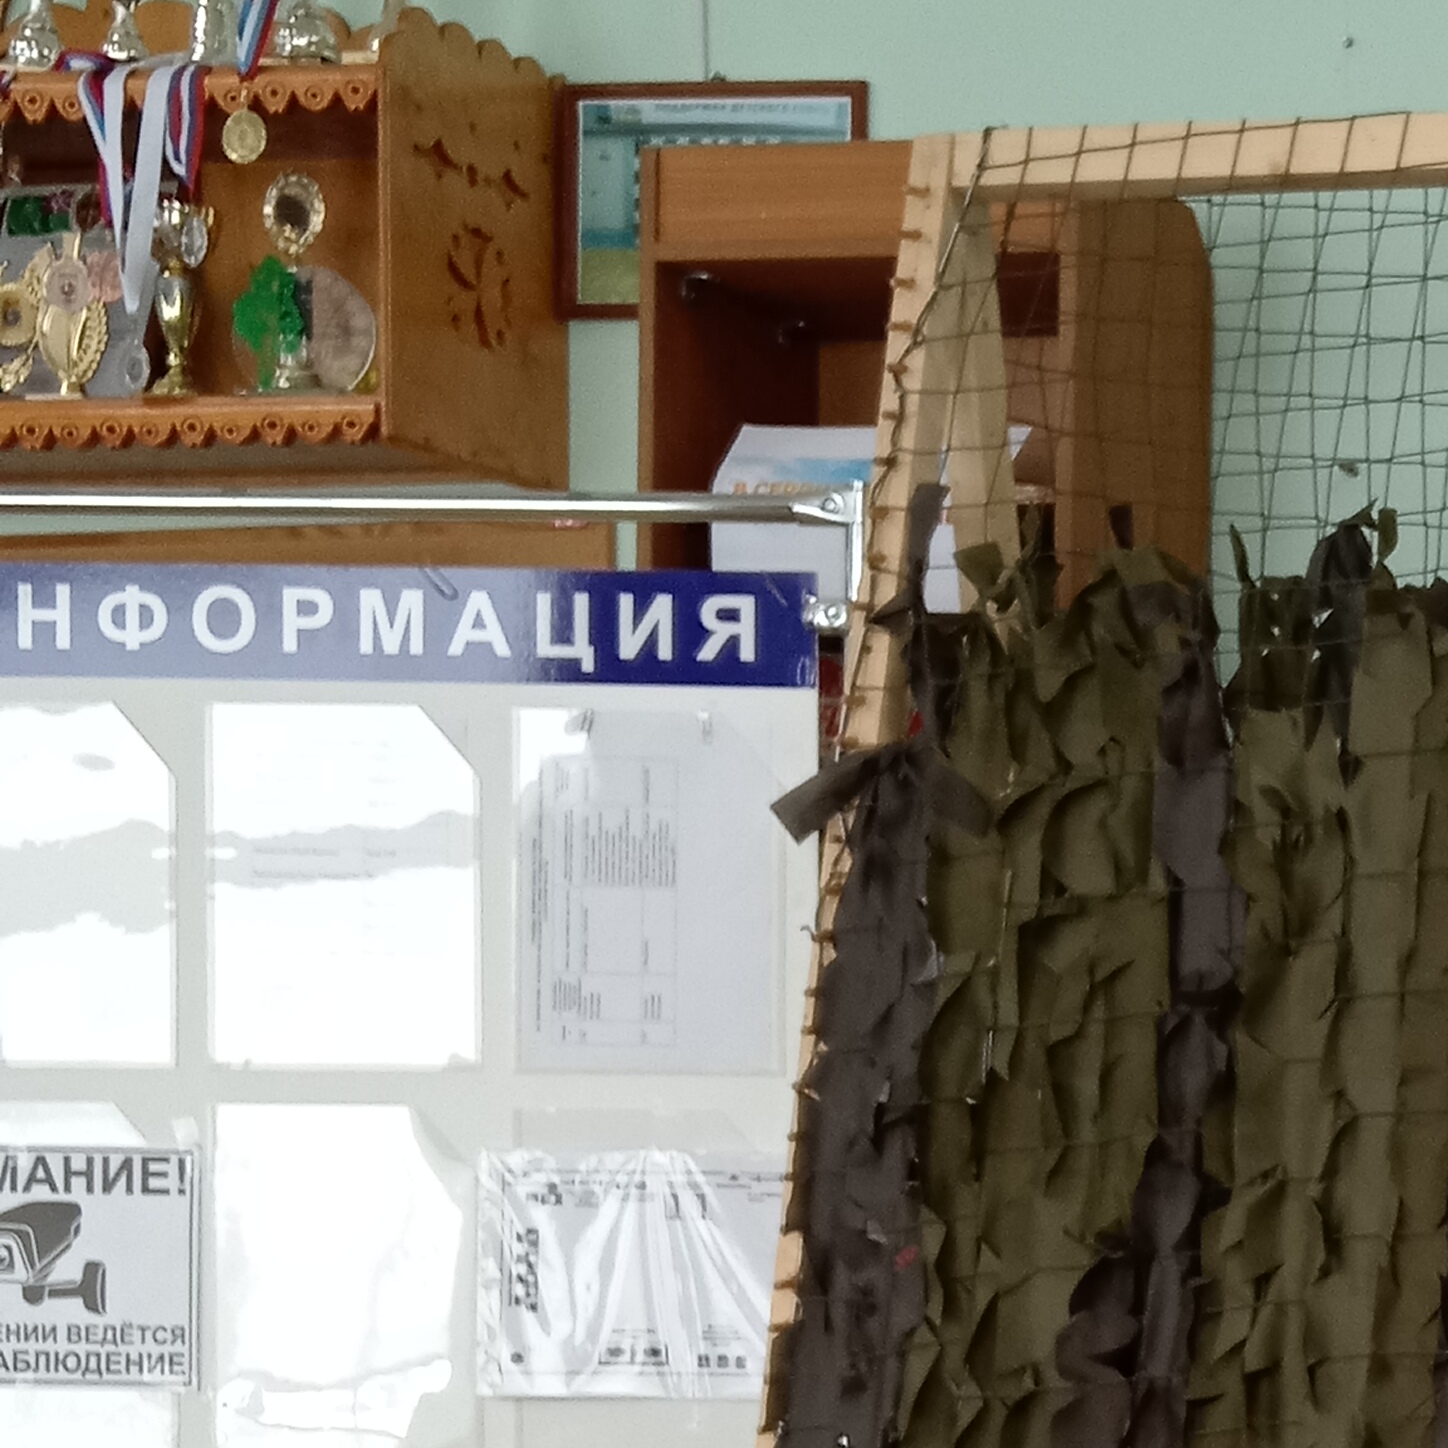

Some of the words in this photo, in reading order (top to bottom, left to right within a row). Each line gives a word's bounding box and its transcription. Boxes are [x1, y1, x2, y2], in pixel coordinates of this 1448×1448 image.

[16, 583, 757, 672] НФОРМАЦИЯ
[0, 1323, 59, 1345] НИИ
[66, 1320, 187, 1348] ВЕДЁТСЯ
